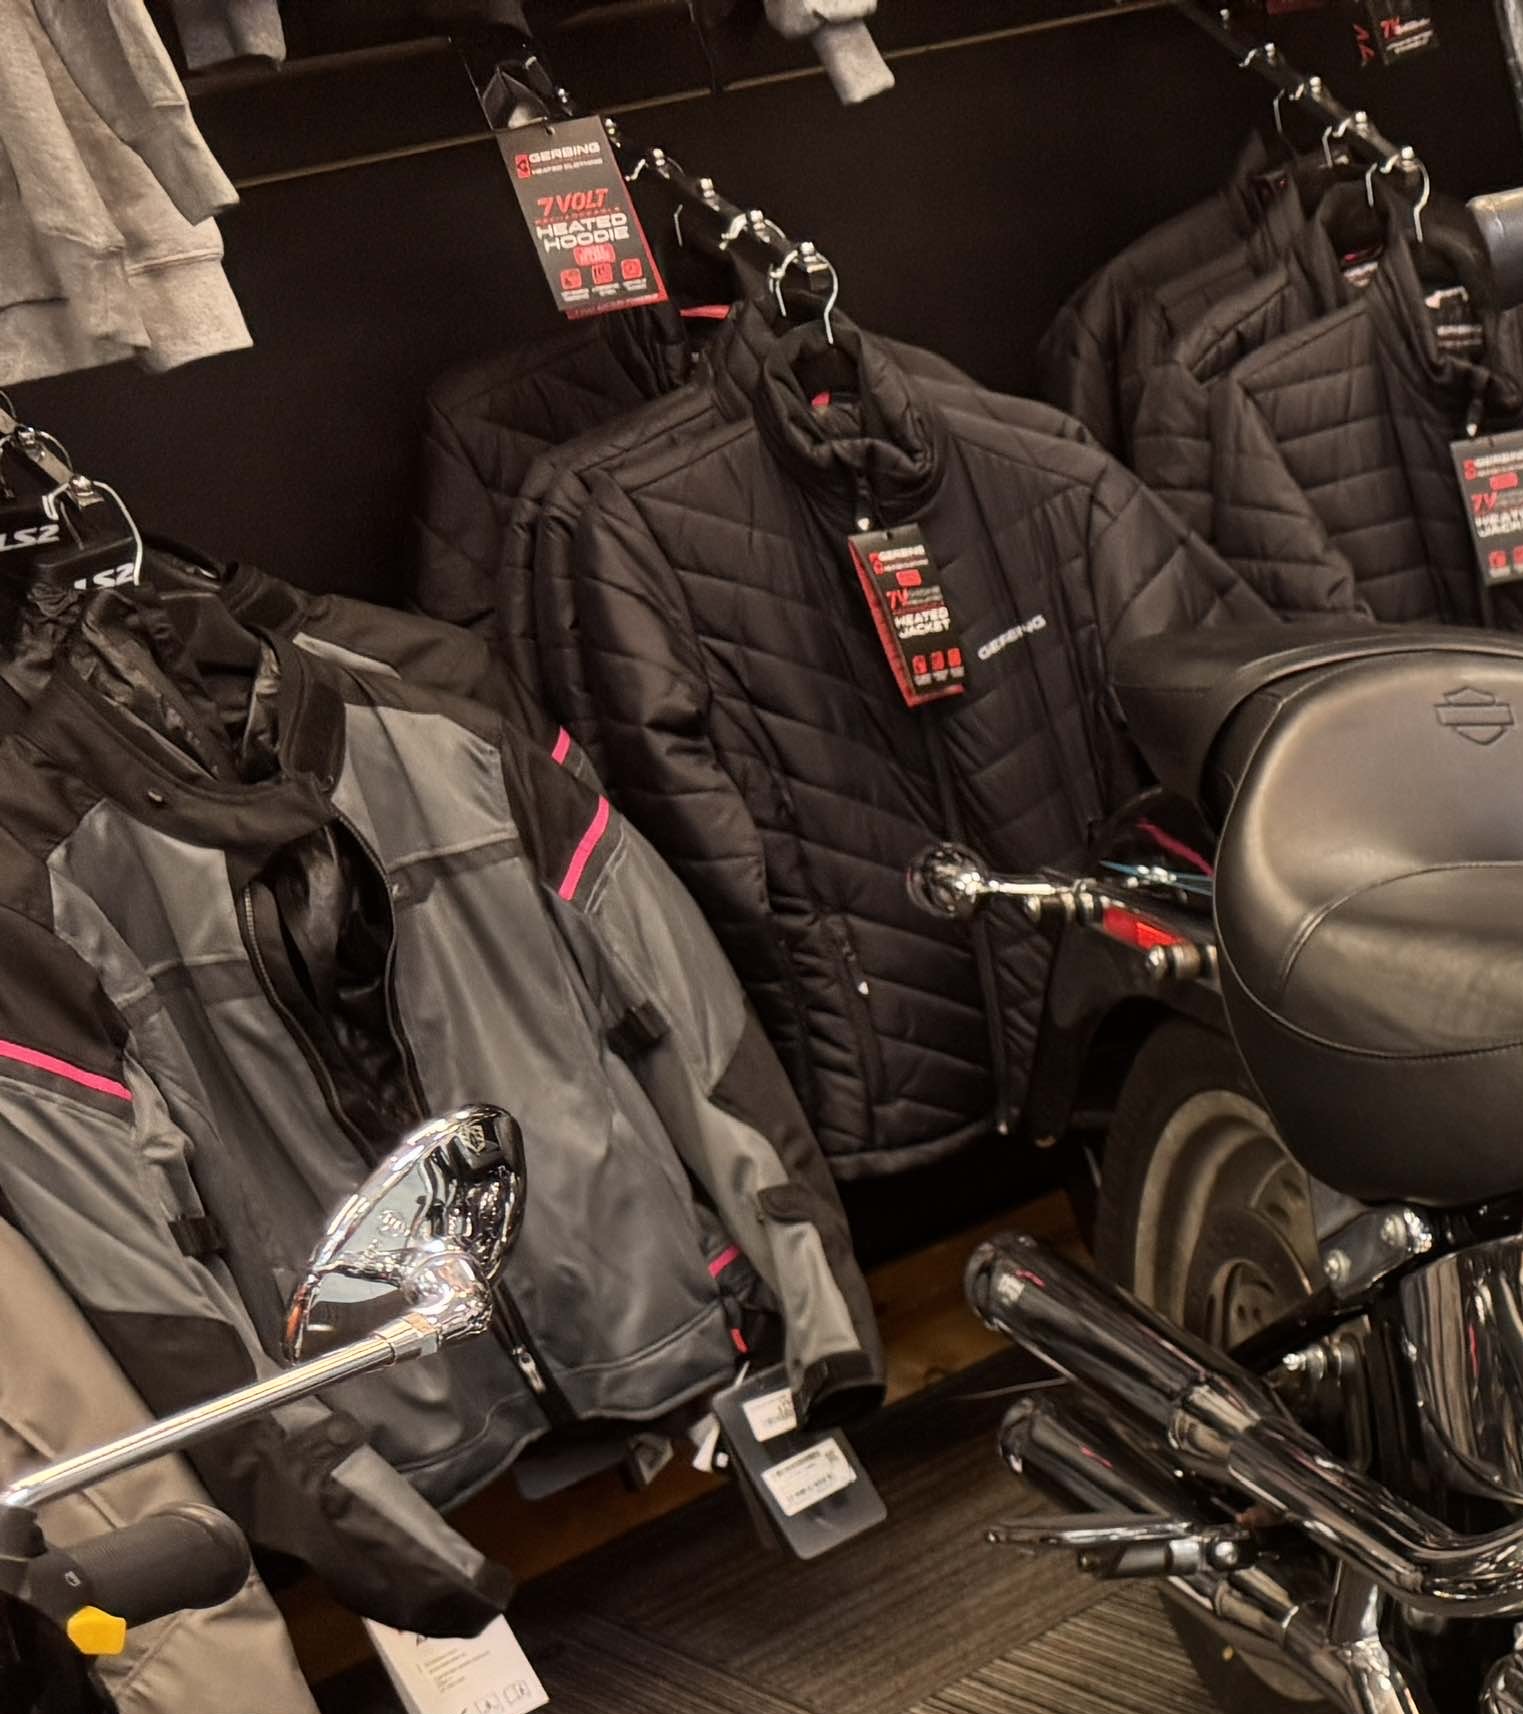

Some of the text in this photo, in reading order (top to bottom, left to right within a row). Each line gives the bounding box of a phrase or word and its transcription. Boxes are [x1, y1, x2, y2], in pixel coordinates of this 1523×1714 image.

[527, 140, 601, 165] GERBING
[554, 186, 613, 214] VOLT
[534, 210, 628, 240] HEATED
[542, 224, 631, 253] HOODIE
